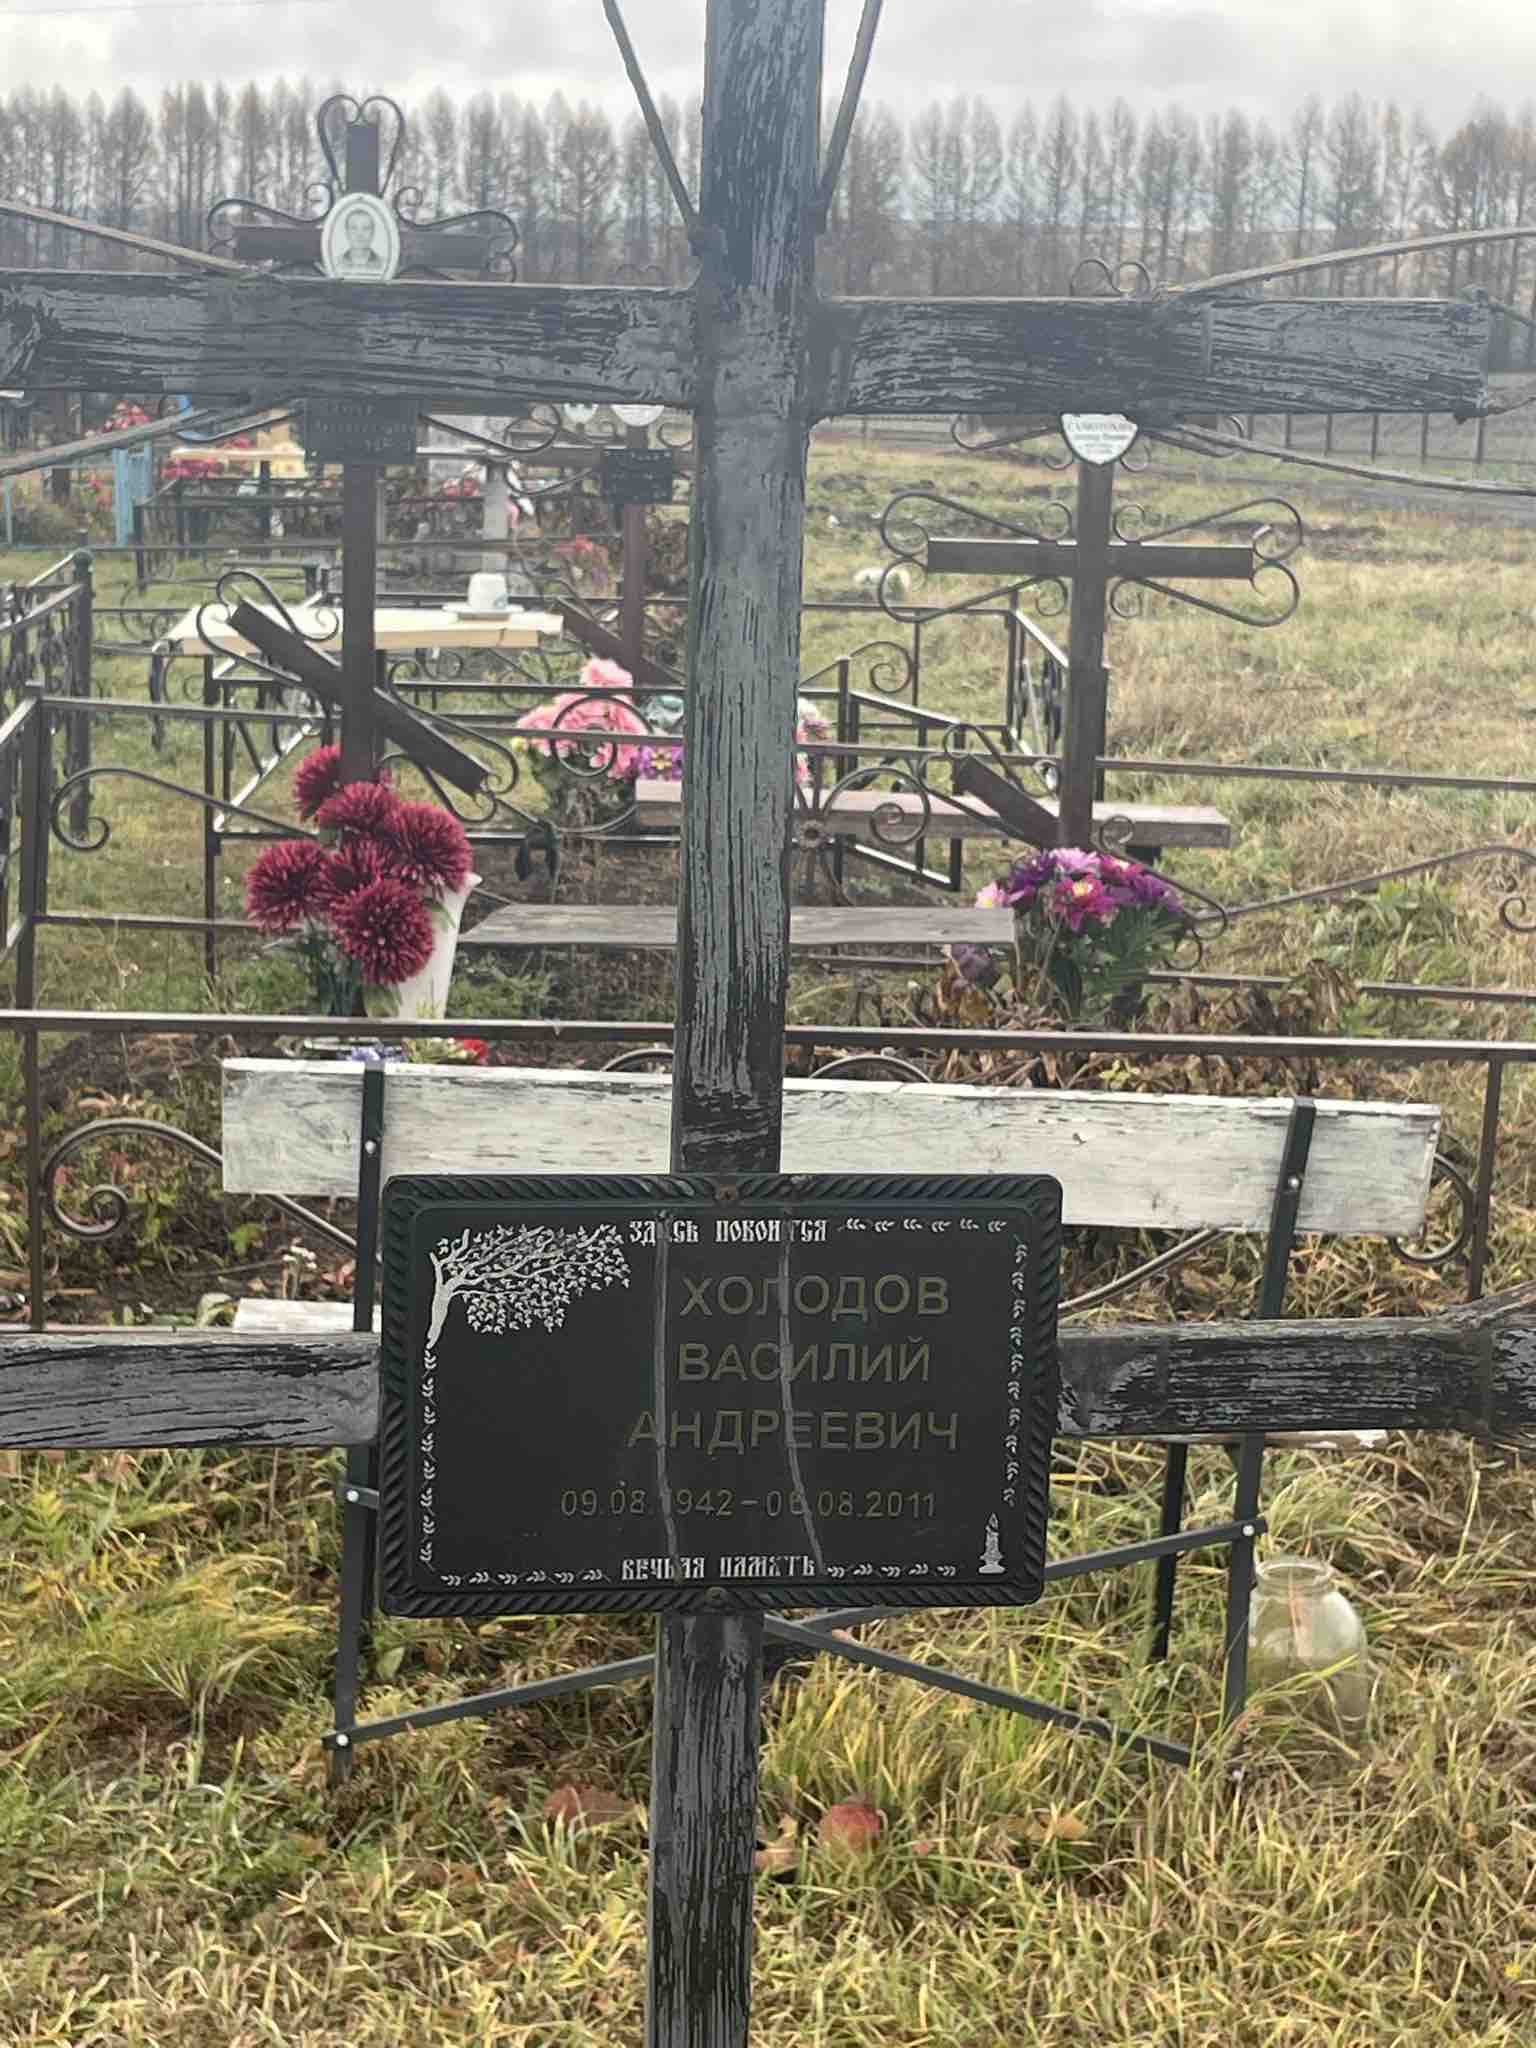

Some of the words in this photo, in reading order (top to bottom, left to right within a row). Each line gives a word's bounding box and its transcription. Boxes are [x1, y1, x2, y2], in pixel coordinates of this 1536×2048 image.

[629, 1219, 699, 1247] ЗДСЬ
[679, 1274, 950, 1322] ХОЛОДОВ
[677, 1335, 931, 1382] ВАСИЛИЙ
[626, 1408, 959, 1456] АНДРЕЕВИЧ
[719, 1554, 816, 1578] ПАМЯТЬ
